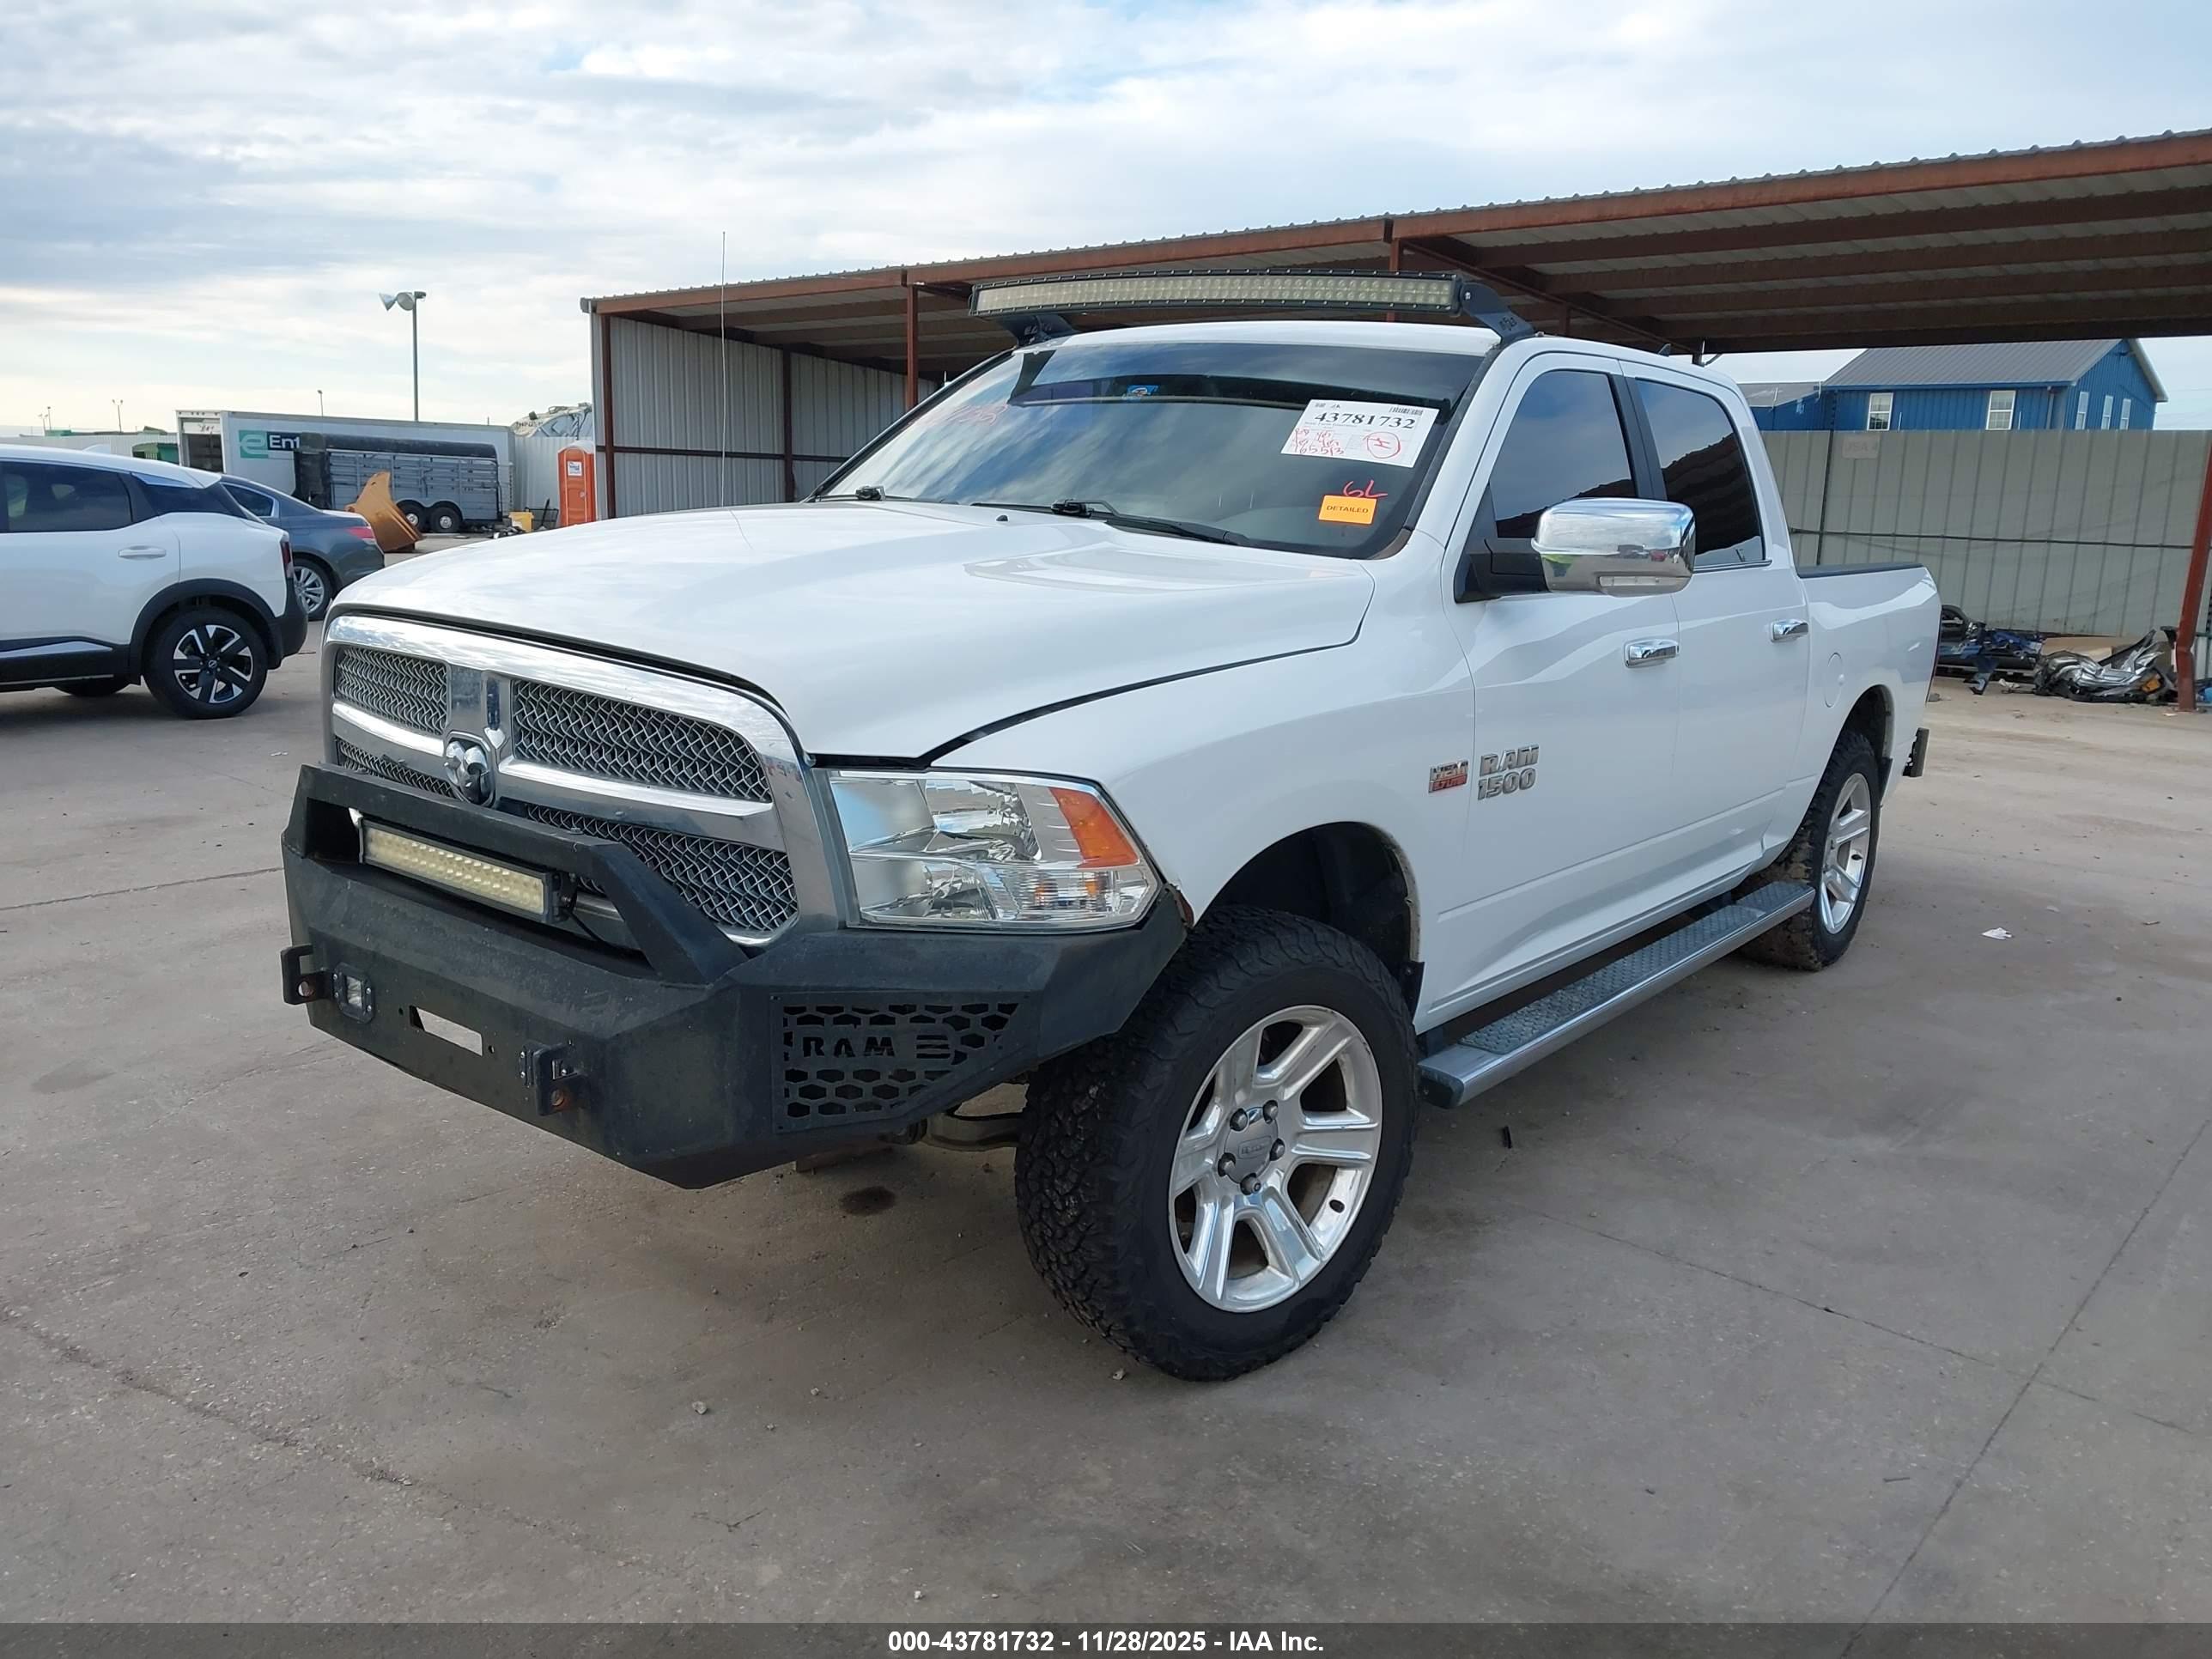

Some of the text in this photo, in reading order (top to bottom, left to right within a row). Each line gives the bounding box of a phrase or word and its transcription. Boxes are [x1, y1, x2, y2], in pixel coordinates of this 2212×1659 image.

[1315, 412, 1416, 429] 43781732
[1326, 505, 1369, 514] DETAILED
[1480, 744, 1540, 777] RAM
[1477, 768, 1537, 800] 1500
[802, 1036, 896, 1058] RAM
